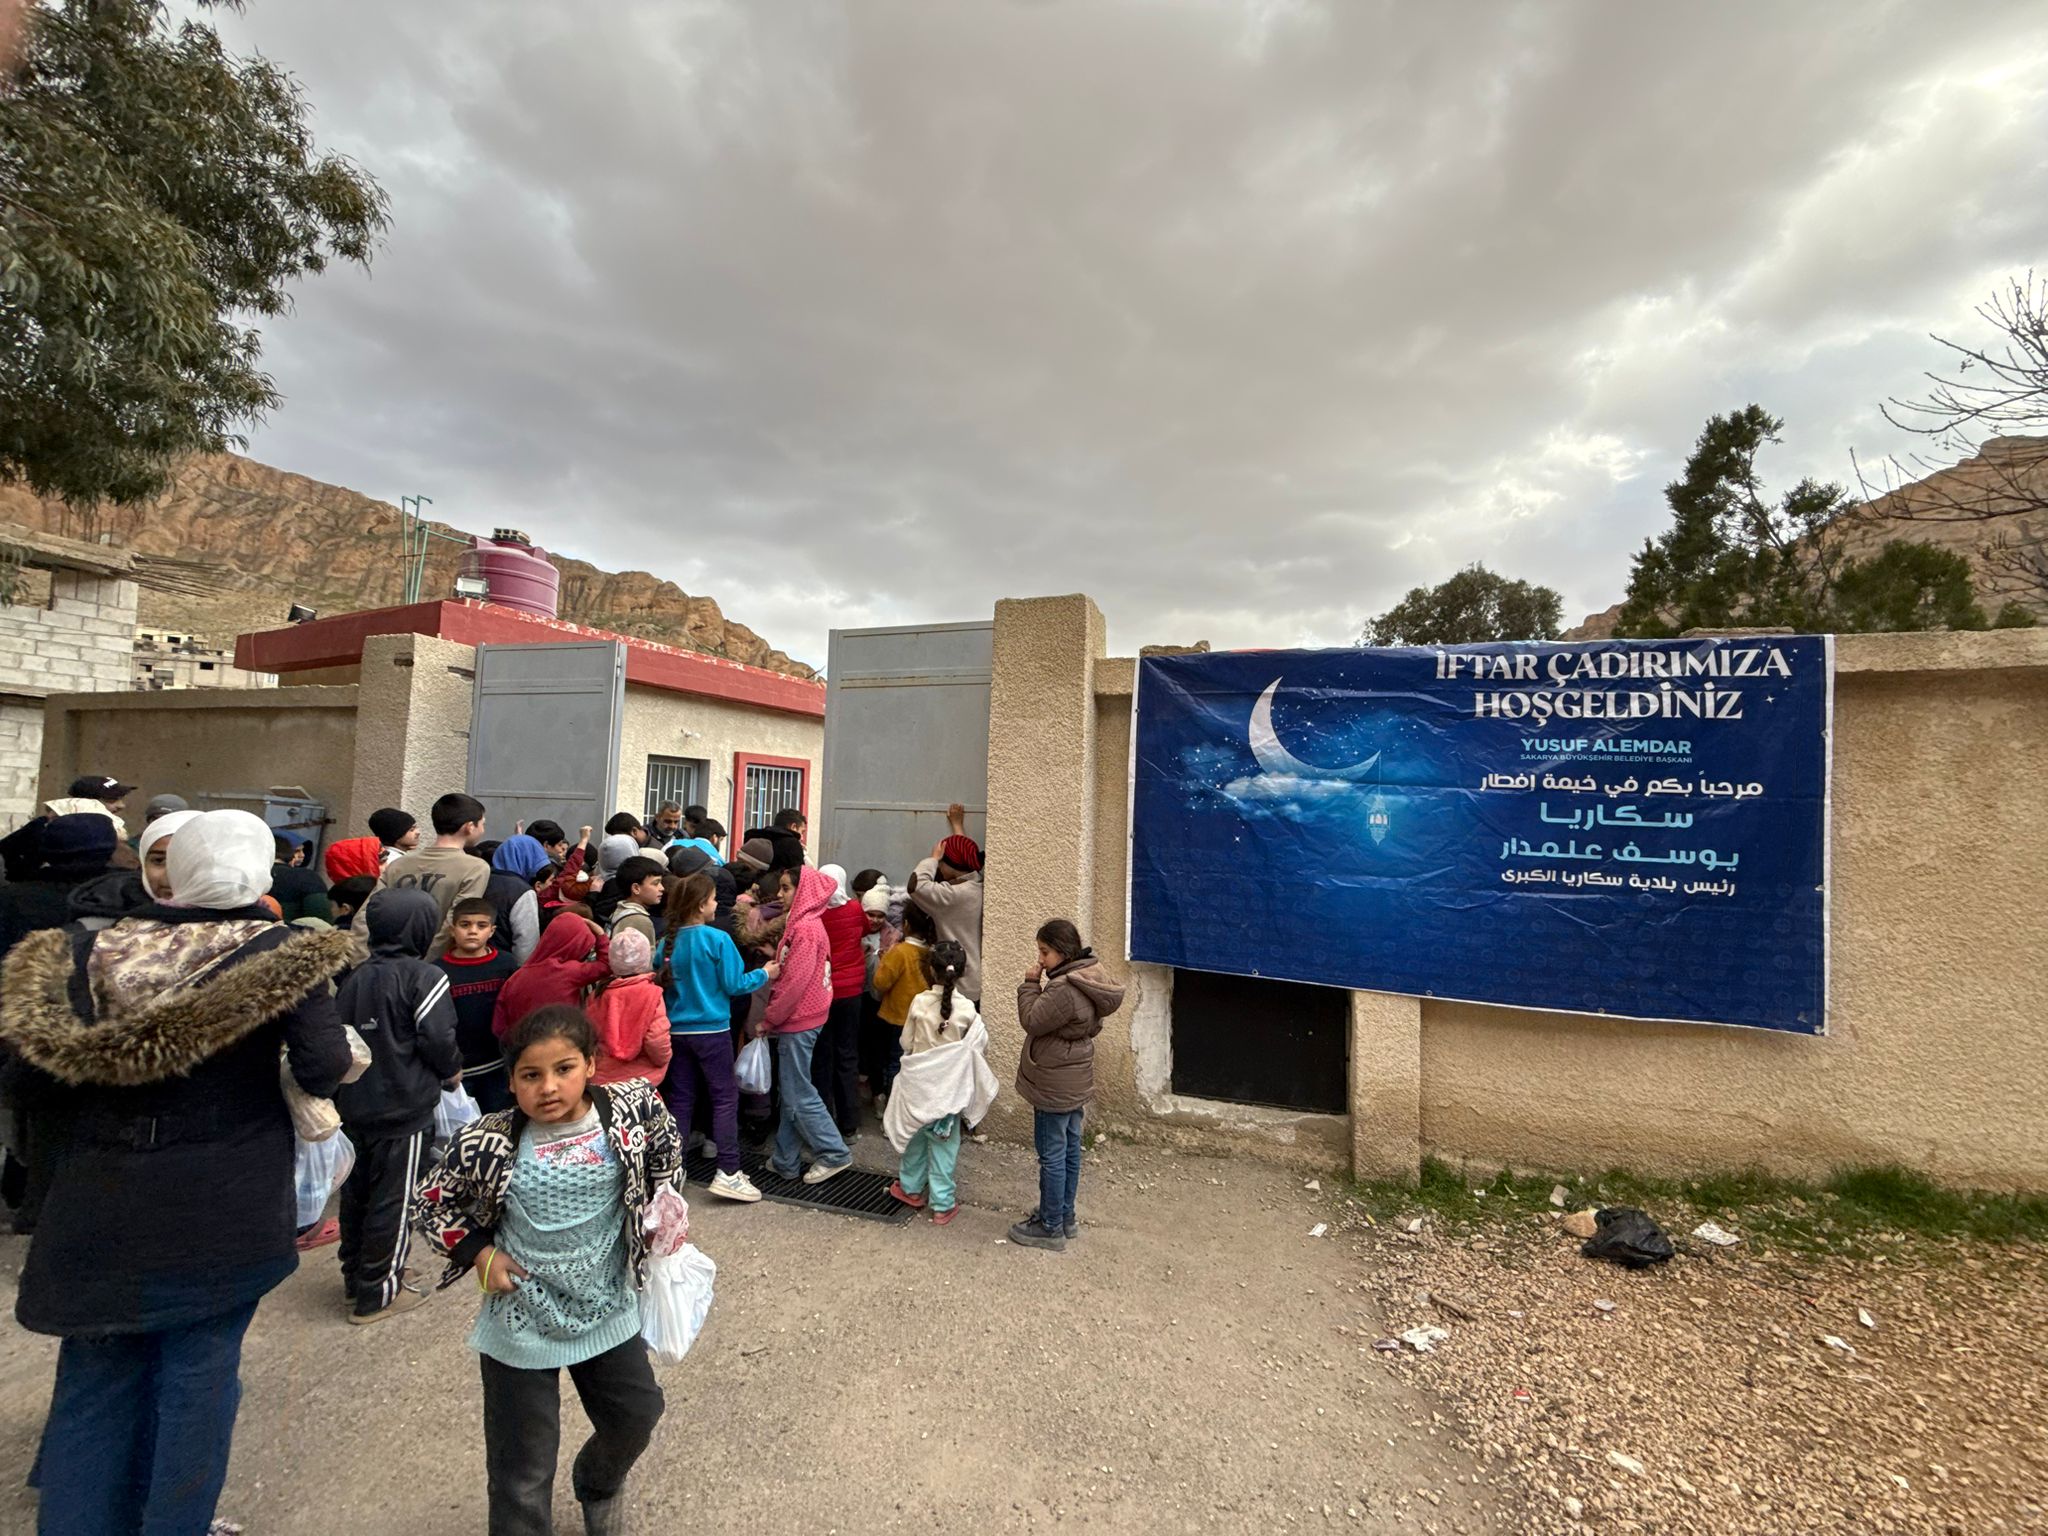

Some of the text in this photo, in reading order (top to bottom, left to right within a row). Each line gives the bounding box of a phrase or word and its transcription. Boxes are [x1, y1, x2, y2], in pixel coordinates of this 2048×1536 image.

[1436, 647, 1793, 688] İFTAR ÇADIRIMIZA
[1473, 681, 1743, 727] HOŞGELDİNİZ
[1520, 738, 1692, 754] YUSUF ALEMDAR
[1520, 753, 1559, 761] SAKARYA
[1614, 754, 1654, 763] BELEDİYE
[1656, 756, 1693, 764] BAŞKANI
[1542, 773, 1597, 794] خيمة
[1604, 775, 1639, 798] في
[1644, 778, 1694, 797] بكم
[1540, 801, 1694, 830] سكاريا
[1500, 837, 1739, 871] يوسف علمدار
[1501, 868, 1736, 897] رئيس بلدية سكاريا الكبرى
